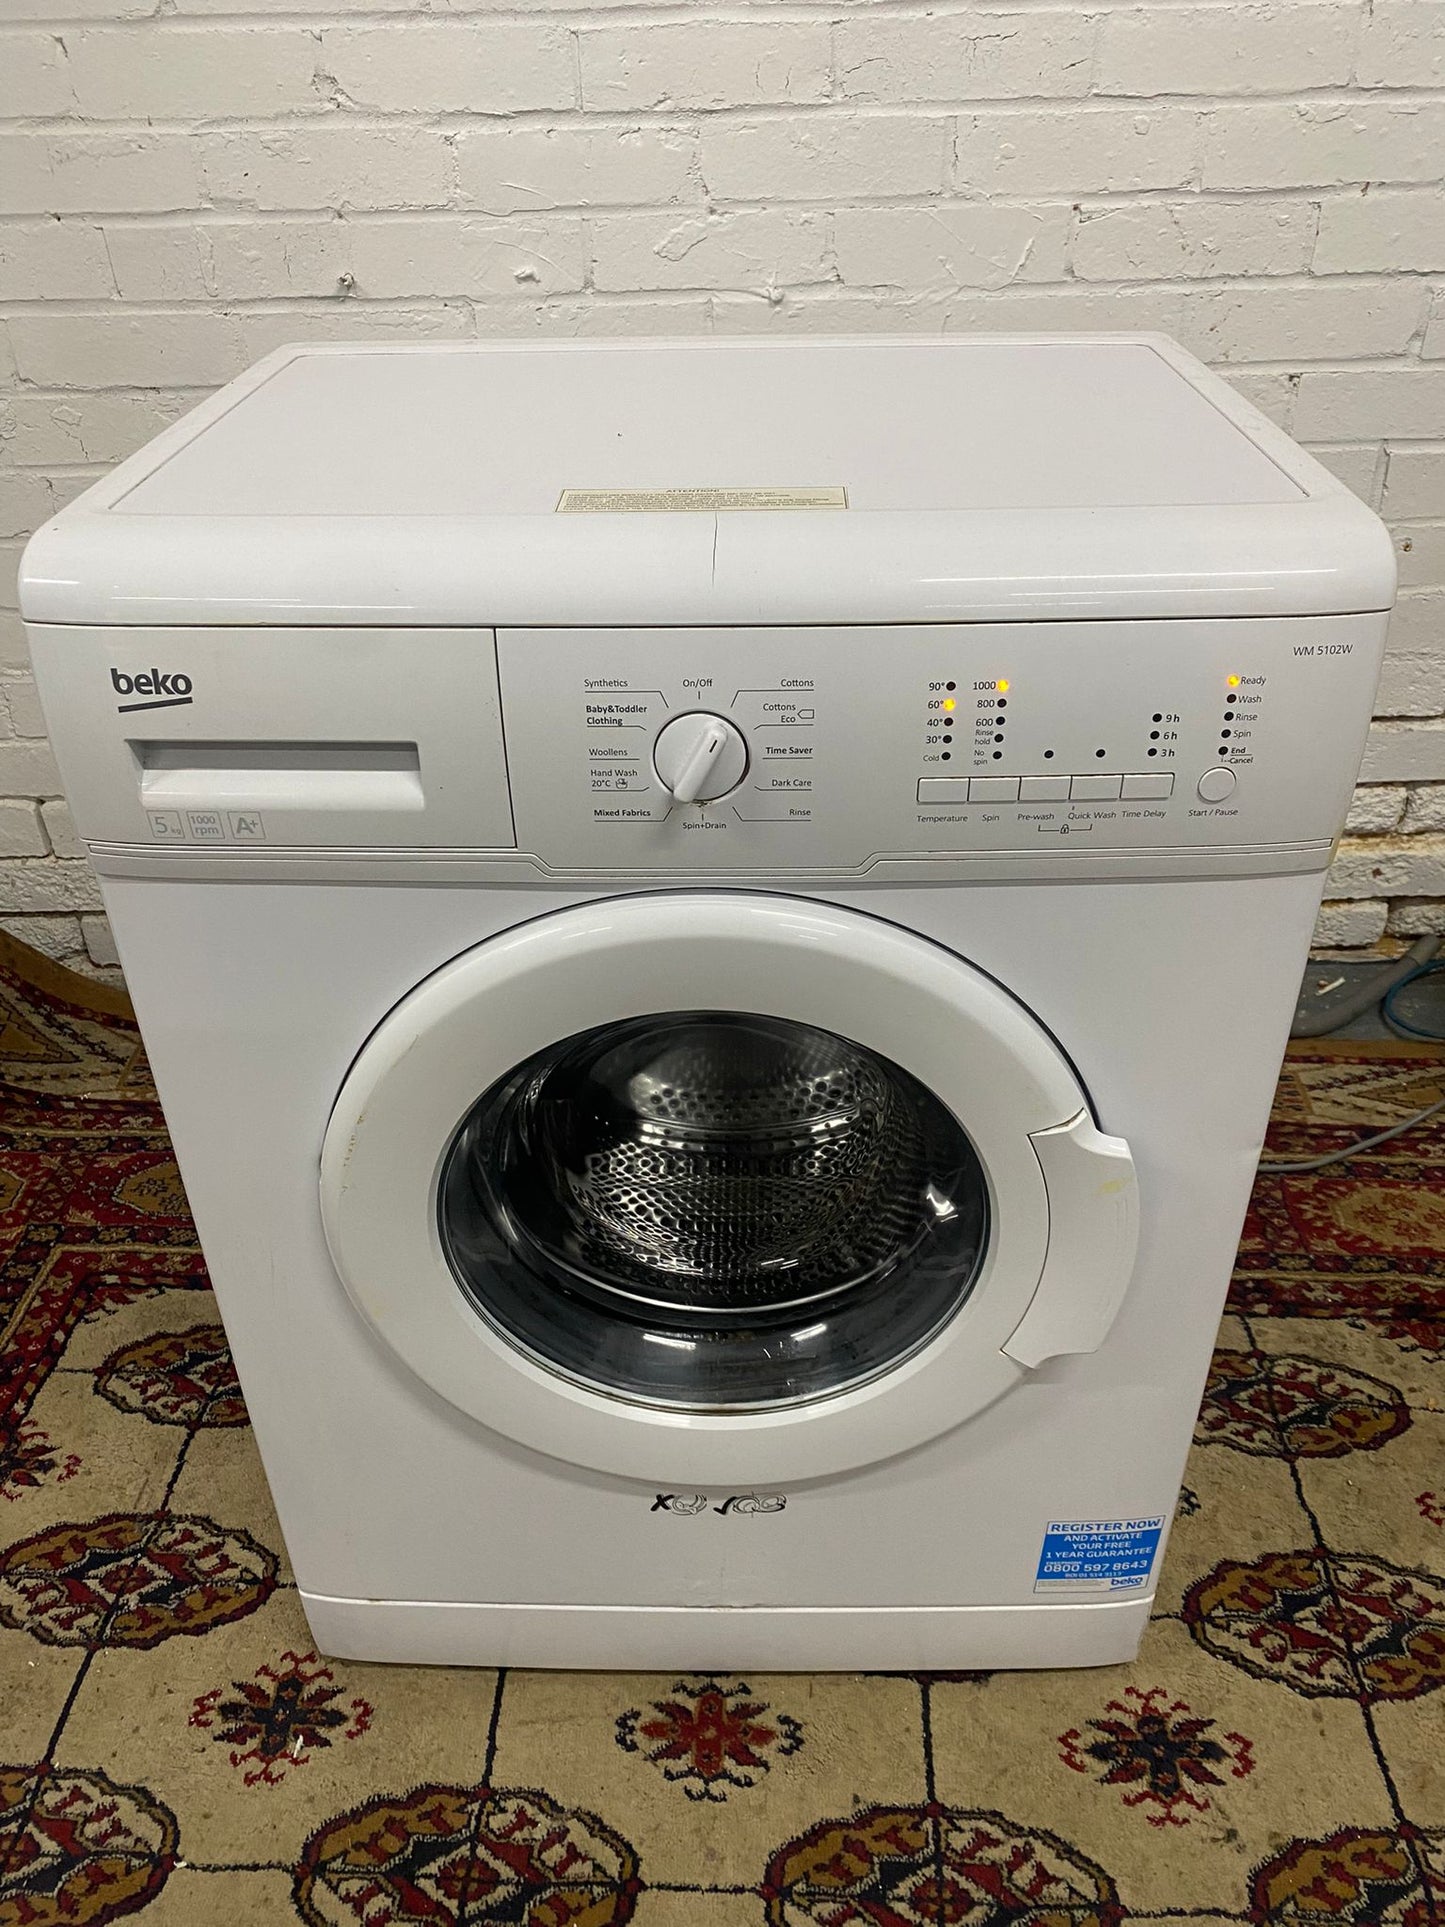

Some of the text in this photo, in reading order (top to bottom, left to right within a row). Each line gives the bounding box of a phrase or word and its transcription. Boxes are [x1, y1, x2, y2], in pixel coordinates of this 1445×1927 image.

[1294, 645, 1353, 656] WM 5102W
[111, 668, 192, 695] beko
[584, 679, 628, 688] Synthetics
[683, 679, 712, 687] On/Off
[781, 679, 814, 687] Cottons
[1241, 676, 1266, 685] Ready
[973, 681, 996, 690] 1000
[1238, 695, 1261, 703] Wash
[763, 703, 796, 711] Cottons
[977, 700, 995, 708] 800
[586, 705, 647, 714] Baby&Toddler
[587, 717, 623, 726] Clothing
[1165, 714, 1172, 722] 9
[1236, 713, 1258, 721] Rinse
[975, 718, 993, 727] 600
[1164, 732, 1177, 740] 6 h
[1233, 730, 1251, 739] Spin
[589, 748, 628, 756] Woollens
[767, 747, 813, 755] Time Saver
[1161, 749, 1175, 757] 3 h
[973, 757, 988, 766] spin
[591, 769, 637, 777] Hand Wash
[772, 779, 812, 787] Dark Care
[594, 809, 620, 817] Mixed
[1017, 813, 1054, 821] Pre-wash
[1068, 811, 1116, 820] Quick Wash
[1122, 809, 1167, 818] Time Delay
[191, 816, 216, 824] 1000
[917, 815, 968, 824] Temperature
[982, 814, 1000, 822] Spin
[154, 817, 168, 833] 5
[236, 817, 258, 833] A+
[682, 822, 726, 830] Spin+Drain
[195, 826, 219, 835] rpm
[1051, 1519, 1161, 1532] REGISTER NOW
[1090, 1532, 1143, 1541] ACTIVATE
[1086, 1547, 1152, 1557] GUARANTEE
[1044, 1560, 1148, 1572] 0800 597 8643
[1111, 1577, 1143, 1586] beko
